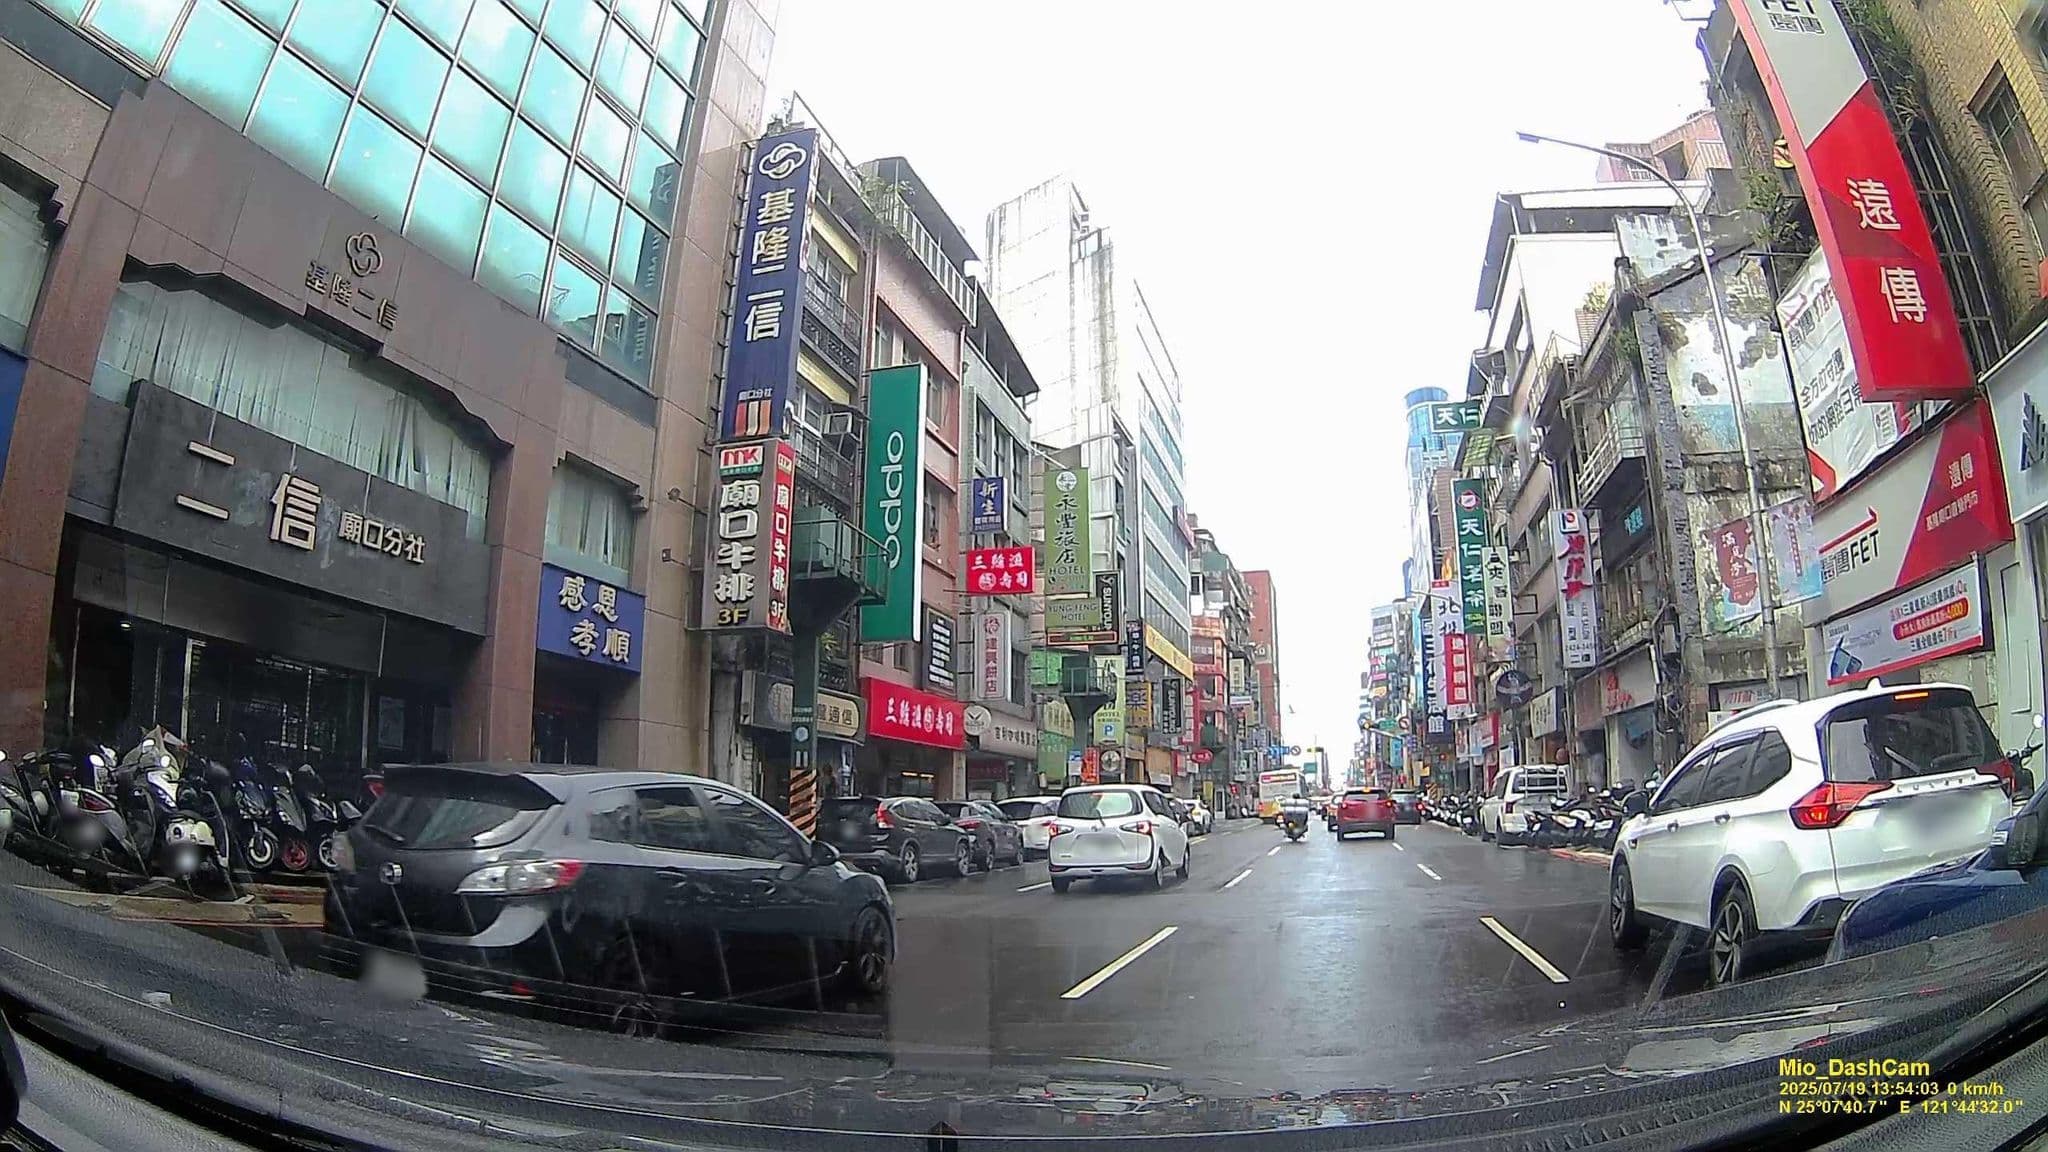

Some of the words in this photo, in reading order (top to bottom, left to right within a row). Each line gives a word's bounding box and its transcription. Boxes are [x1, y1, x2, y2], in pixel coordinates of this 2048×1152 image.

[744, 187, 796, 342] 基隆二信
[1846, 177, 1928, 324] 遠傳
[304, 260, 398, 331] 基隆二信
[1436, 406, 1479, 426] 天仁
[1948, 451, 1975, 490] 遠傳
[176, 441, 322, 552] 二信
[339, 511, 426, 565] 廟口分社
[713, 479, 762, 603] 廟口牛排
[771, 484, 790, 593] 廟口牛排
[1459, 517, 1485, 608] 天仁茗茶
[1049, 566, 1085, 575] HOTEL
[559, 575, 620, 623] 感恩
[717, 607, 748, 625] 3F
[771, 600, 785, 619] 3F
[1061, 613, 1087, 622] HOTEL
[568, 618, 632, 665] 孝順
